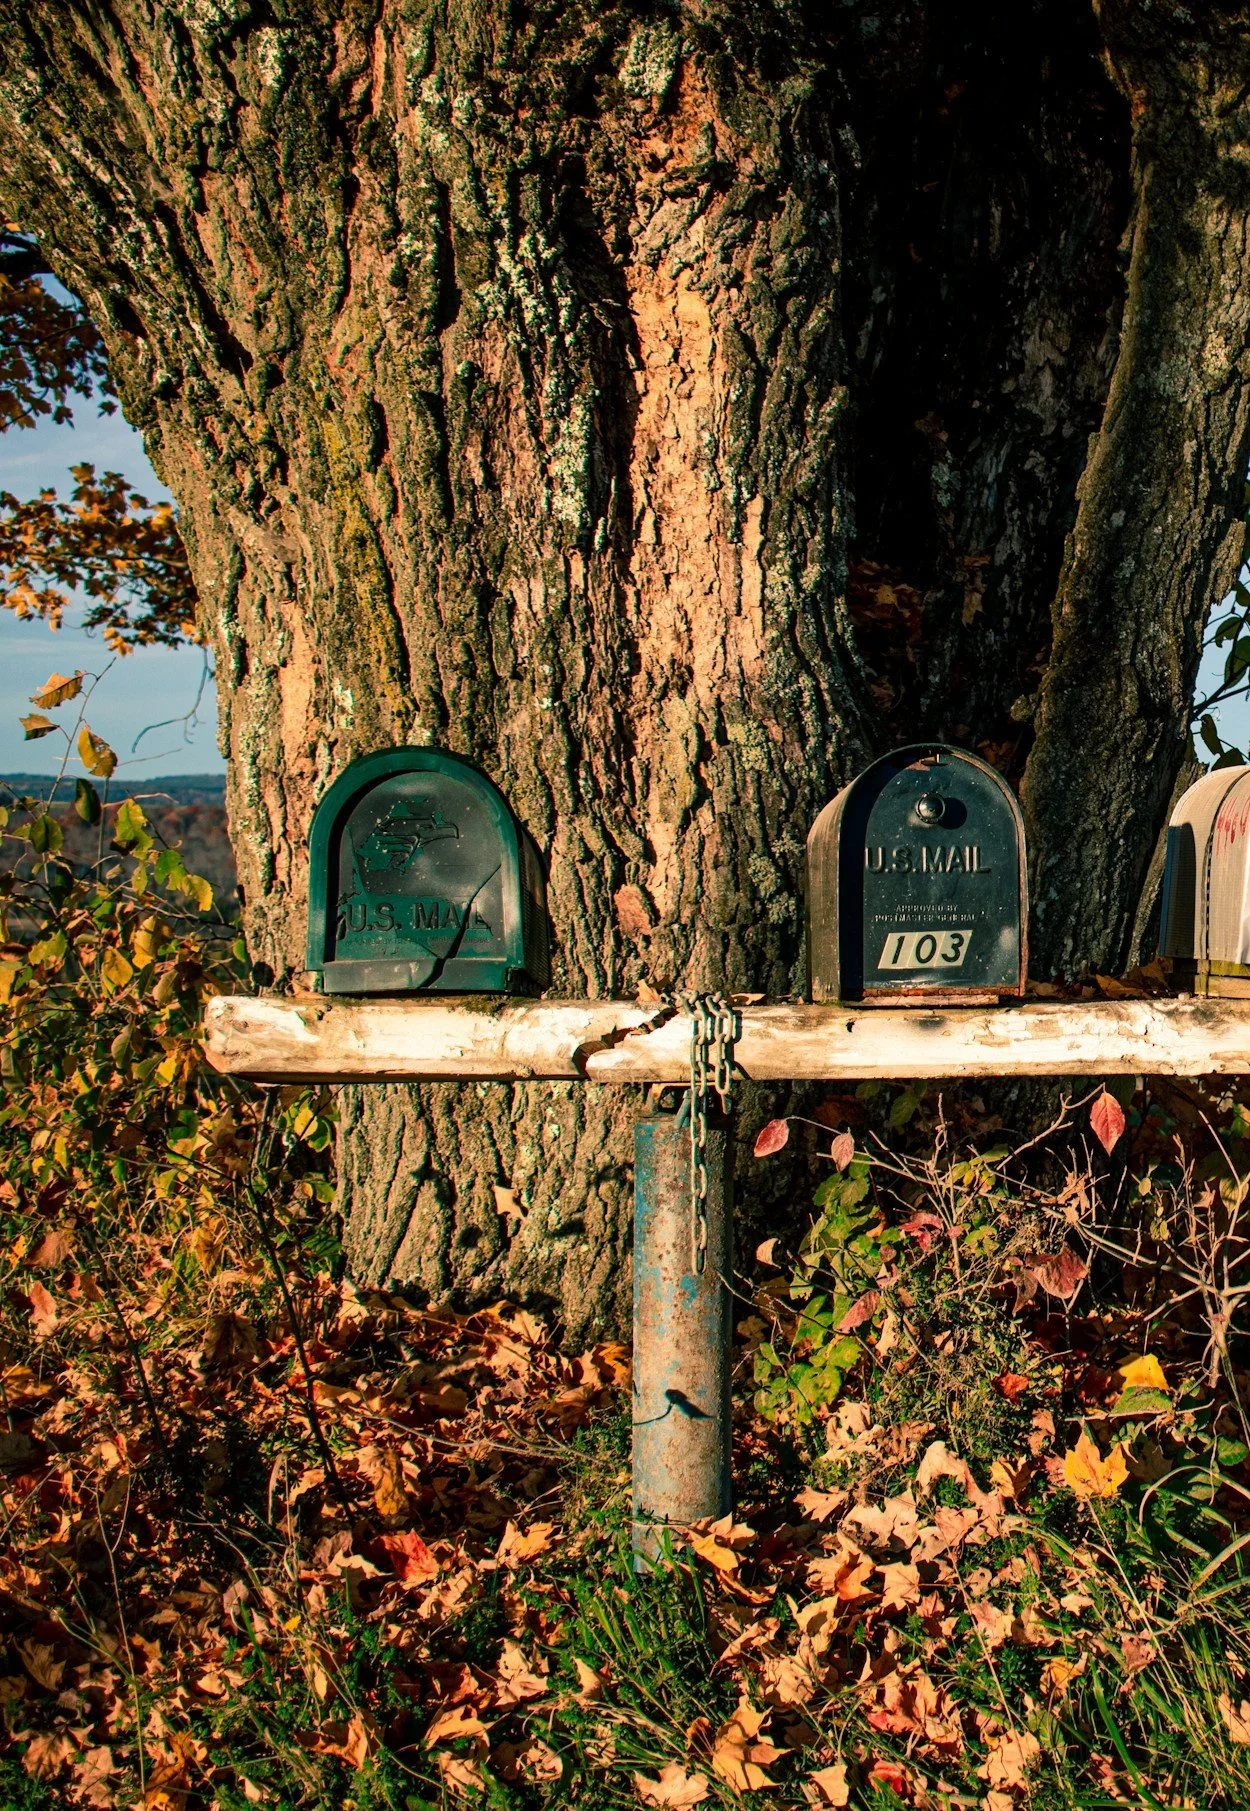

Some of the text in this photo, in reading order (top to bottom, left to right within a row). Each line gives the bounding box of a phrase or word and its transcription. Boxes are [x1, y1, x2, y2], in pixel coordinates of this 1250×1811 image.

[346, 901, 401, 932] U.S.
[873, 913, 977, 923] POSTMASTER GENERAL
[895, 904, 959, 913] APPROVED BY
[890, 932, 966, 966] 103
